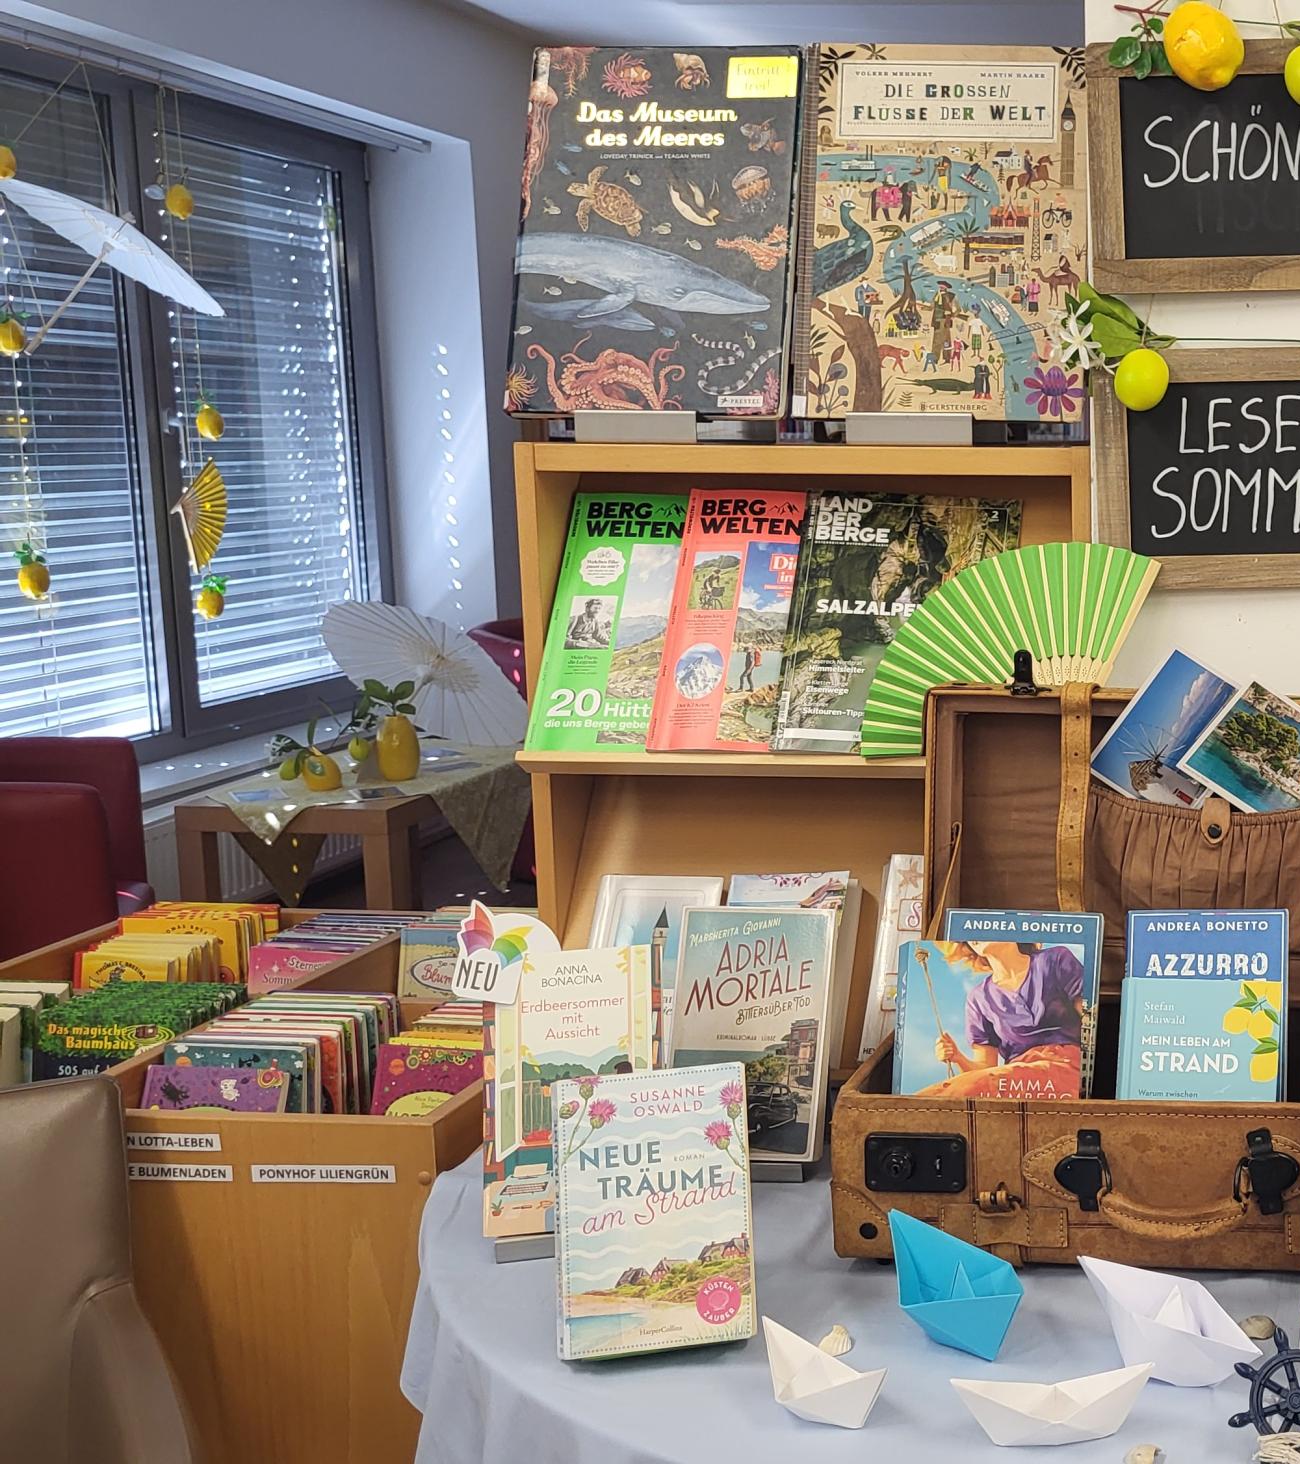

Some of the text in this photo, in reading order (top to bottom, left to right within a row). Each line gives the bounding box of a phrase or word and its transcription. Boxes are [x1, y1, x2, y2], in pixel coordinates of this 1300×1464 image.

[884, 83, 1012, 98] DIE GROSSEN
[576, 101, 738, 122] Das Museum
[940, 106, 975, 121] DER
[990, 105, 1047, 121] WELT
[585, 125, 725, 147] des Meeres
[926, 402, 988, 413] GERSTENBERG
[587, 501, 653, 519] BERG
[701, 499, 766, 516] BERG
[820, 495, 873, 513] LAND
[700, 517, 801, 536] WELTEN
[817, 511, 861, 527] DER
[586, 520, 684, 538] WELTEN
[815, 525, 891, 543] BERGE
[808, 665, 866, 674] Himmelsleiter
[805, 686, 849, 695] Eisenwege
[546, 688, 602, 718] 20
[603, 701, 652, 717] Hütt
[544, 719, 565, 728] die
[566, 721, 582, 729] uns
[584, 719, 617, 730] Berge
[742, 917, 782, 936] GIOVANNI
[963, 919, 1084, 934] ANDREA BONETTO
[1147, 920, 1269, 932] ANDREA BONETTO
[715, 932, 789, 977] ADRIA
[554, 965, 589, 976] ANNA
[1145, 952, 1269, 977] AZZURRO
[456, 959, 499, 992] NEU
[541, 975, 603, 988] BONACINA
[684, 959, 815, 1016] MORTALE
[521, 995, 625, 1014] Erdbeersommer
[793, 995, 811, 1012] TOD
[1144, 1001, 1174, 1012] Stefan
[562, 1012, 584, 1024] mit
[1143, 1014, 1185, 1025] Maiwald
[48, 1024, 128, 1038] Das magische
[544, 1026, 601, 1041] Aussicht
[65, 1036, 136, 1050] Baumhaus
[1141, 1035, 1231, 1048] MEIN LEBEN AM
[58, 1065, 78, 1076] SOS
[1140, 1051, 1240, 1074] STRAND
[998, 1078, 1056, 1092] EMMA
[630, 1085, 706, 1104] SUSANNE
[1138, 1088, 1198, 1099] Warum zwischen
[633, 1101, 703, 1118] OSWALD
[138, 1136, 214, 1148] LOTTA-LEBEN
[578, 1141, 662, 1171] NEUE
[673, 1153, 706, 1163] ROMAN
[138, 1167, 227, 1179] BLUMENLADEN
[259, 1166, 389, 1180] PONYHOF LILIENGRÜN
[597, 1164, 724, 1200] TRÄUME
[582, 1171, 736, 1236] am Strand
[703, 1280, 735, 1297] KÜSTEN
[702, 1306, 736, 1323] ZAUBER
[639, 1324, 683, 1336] HarperCollins
